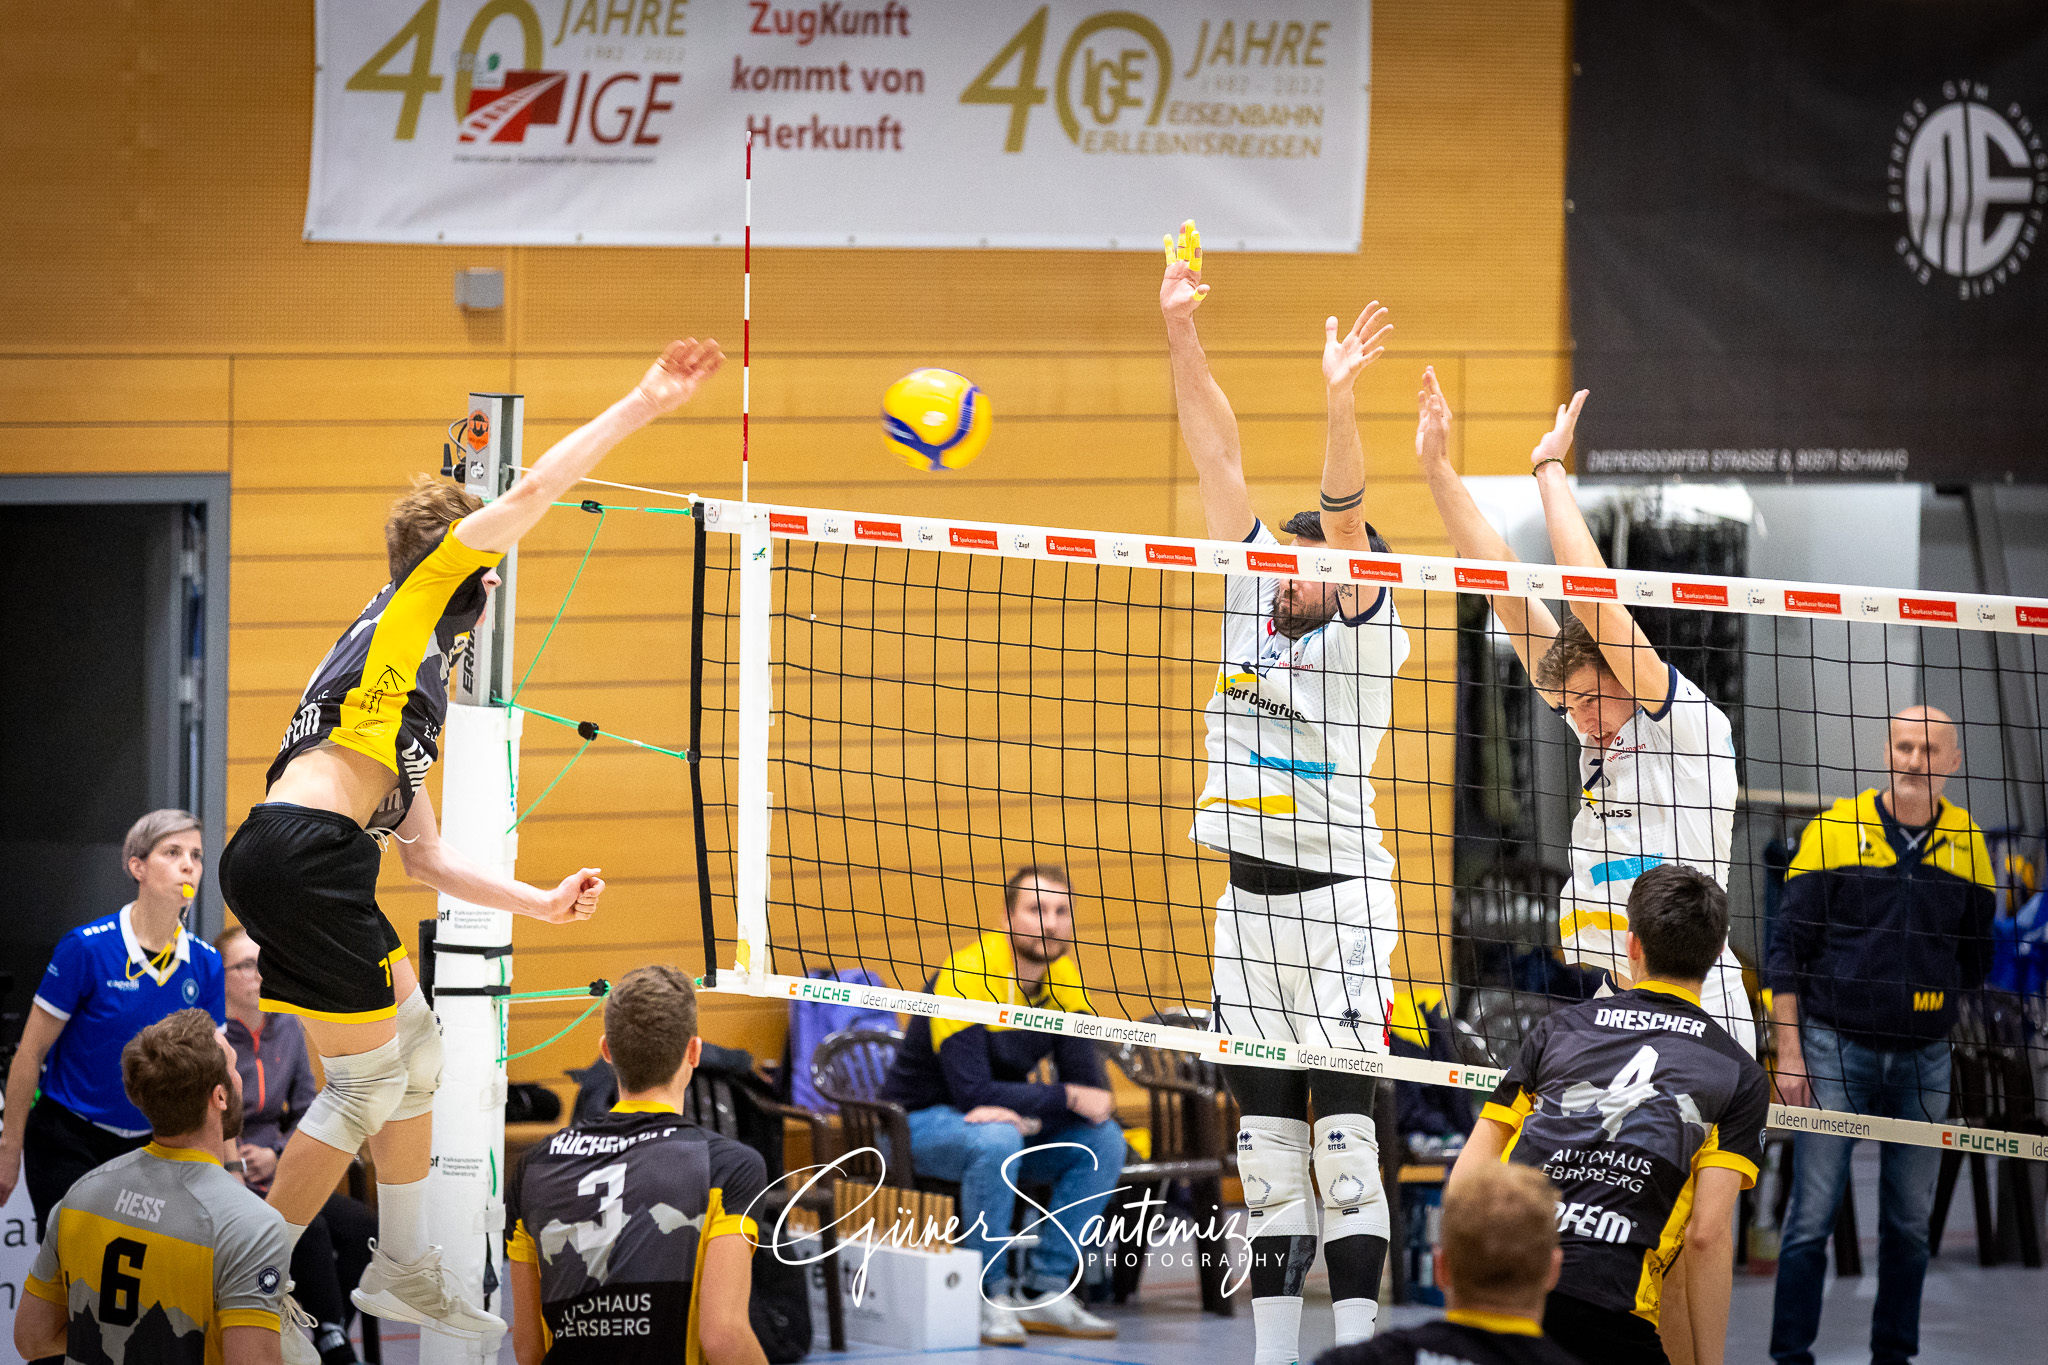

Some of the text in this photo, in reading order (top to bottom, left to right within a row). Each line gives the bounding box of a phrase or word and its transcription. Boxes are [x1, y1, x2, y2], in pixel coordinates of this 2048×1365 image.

[552, 0, 689, 47] JAHRE
[748, 1, 910, 46] ZugKunft
[1184, 19, 1332, 80] JAHRE
[731, 55, 926, 94] kommt von
[566, 71, 682, 146] IGE
[1167, 101, 1325, 129] EISENBAHN
[746, 113, 903, 151] Herkunft
[1082, 128, 1324, 160] ERLEBNISREISEN
[828, 526, 839, 535] Zapf
[864, 529, 882, 538] Sparkasse
[882, 530, 899, 540] Nürnberg
[922, 533, 934, 542] Zapf
[959, 537, 977, 546] Sparkasse
[977, 538, 995, 548] Nürnberg
[1018, 541, 1030, 550] Zapf
[1056, 545, 1074, 554] Sparkasse
[1075, 546, 1093, 556] Nürnberg
[1118, 549, 1129, 558] Zapf
[1156, 553, 1174, 562] Sparkasse
[1175, 554, 1193, 564] Nürnberg
[1218, 557, 1229, 566] Zapf
[1257, 561, 1276, 570] Sparkasse
[1276, 562, 1295, 572] Nürnberg
[1320, 565, 1332, 574] Zapf
[1360, 568, 1379, 576] Sparkasse
[1379, 570, 1399, 578] Nürnberg
[1424, 573, 1437, 582] Zapf
[1465, 577, 1485, 586] Sparkasse
[1485, 578, 1505, 588] Nürnberg
[1532, 581, 1544, 590] Zapf
[1573, 585, 1593, 594] Sparkasse
[1594, 586, 1614, 596] Nürnberg
[1642, 589, 1654, 598] Zapf
[1683, 592, 1704, 600] Sparkasse
[1704, 594, 1725, 602] Nürnberg
[1752, 597, 1765, 606] Zapf
[1795, 600, 1816, 608] Sparkasse
[1817, 602, 1838, 610] Nürnberg
[1866, 605, 1879, 614] Zapf
[1911, 607, 1932, 616] Sparkasse
[1932, 608, 1954, 618] Nürnberg
[1982, 613, 1995, 622] Zapf
[1223, 686, 1250, 700] apf
[802, 984, 851, 1002] FUCHS
[860, 990, 889, 1008] Ideen
[890, 993, 940, 1015] umsetzen
[1913, 990, 1945, 1012] MM
[1013, 1012, 1064, 1032] FUCHS
[1073, 1020, 1103, 1038] Ideen
[1105, 1024, 1157, 1044] umsetzen
[1594, 1008, 1708, 1039] DRESCHER
[1234, 1041, 1287, 1062] FUCHS
[1297, 1049, 1328, 1069] Ideen
[1330, 1053, 1384, 1074] umsetzen
[1464, 1072, 1503, 1089] FUC
[1602, 1044, 1659, 1109] 4
[1775, 1110, 1871, 1136] Ideen umsetzen
[1959, 1133, 2019, 1154] FUCHS
[2032, 1141, 2048, 1158] Ide
[1549, 1148, 1653, 1176] AUTOHAUS
[114, 1188, 167, 1224] HESS
[577, 1162, 628, 1251] 3
[99, 1236, 148, 1328] 6
